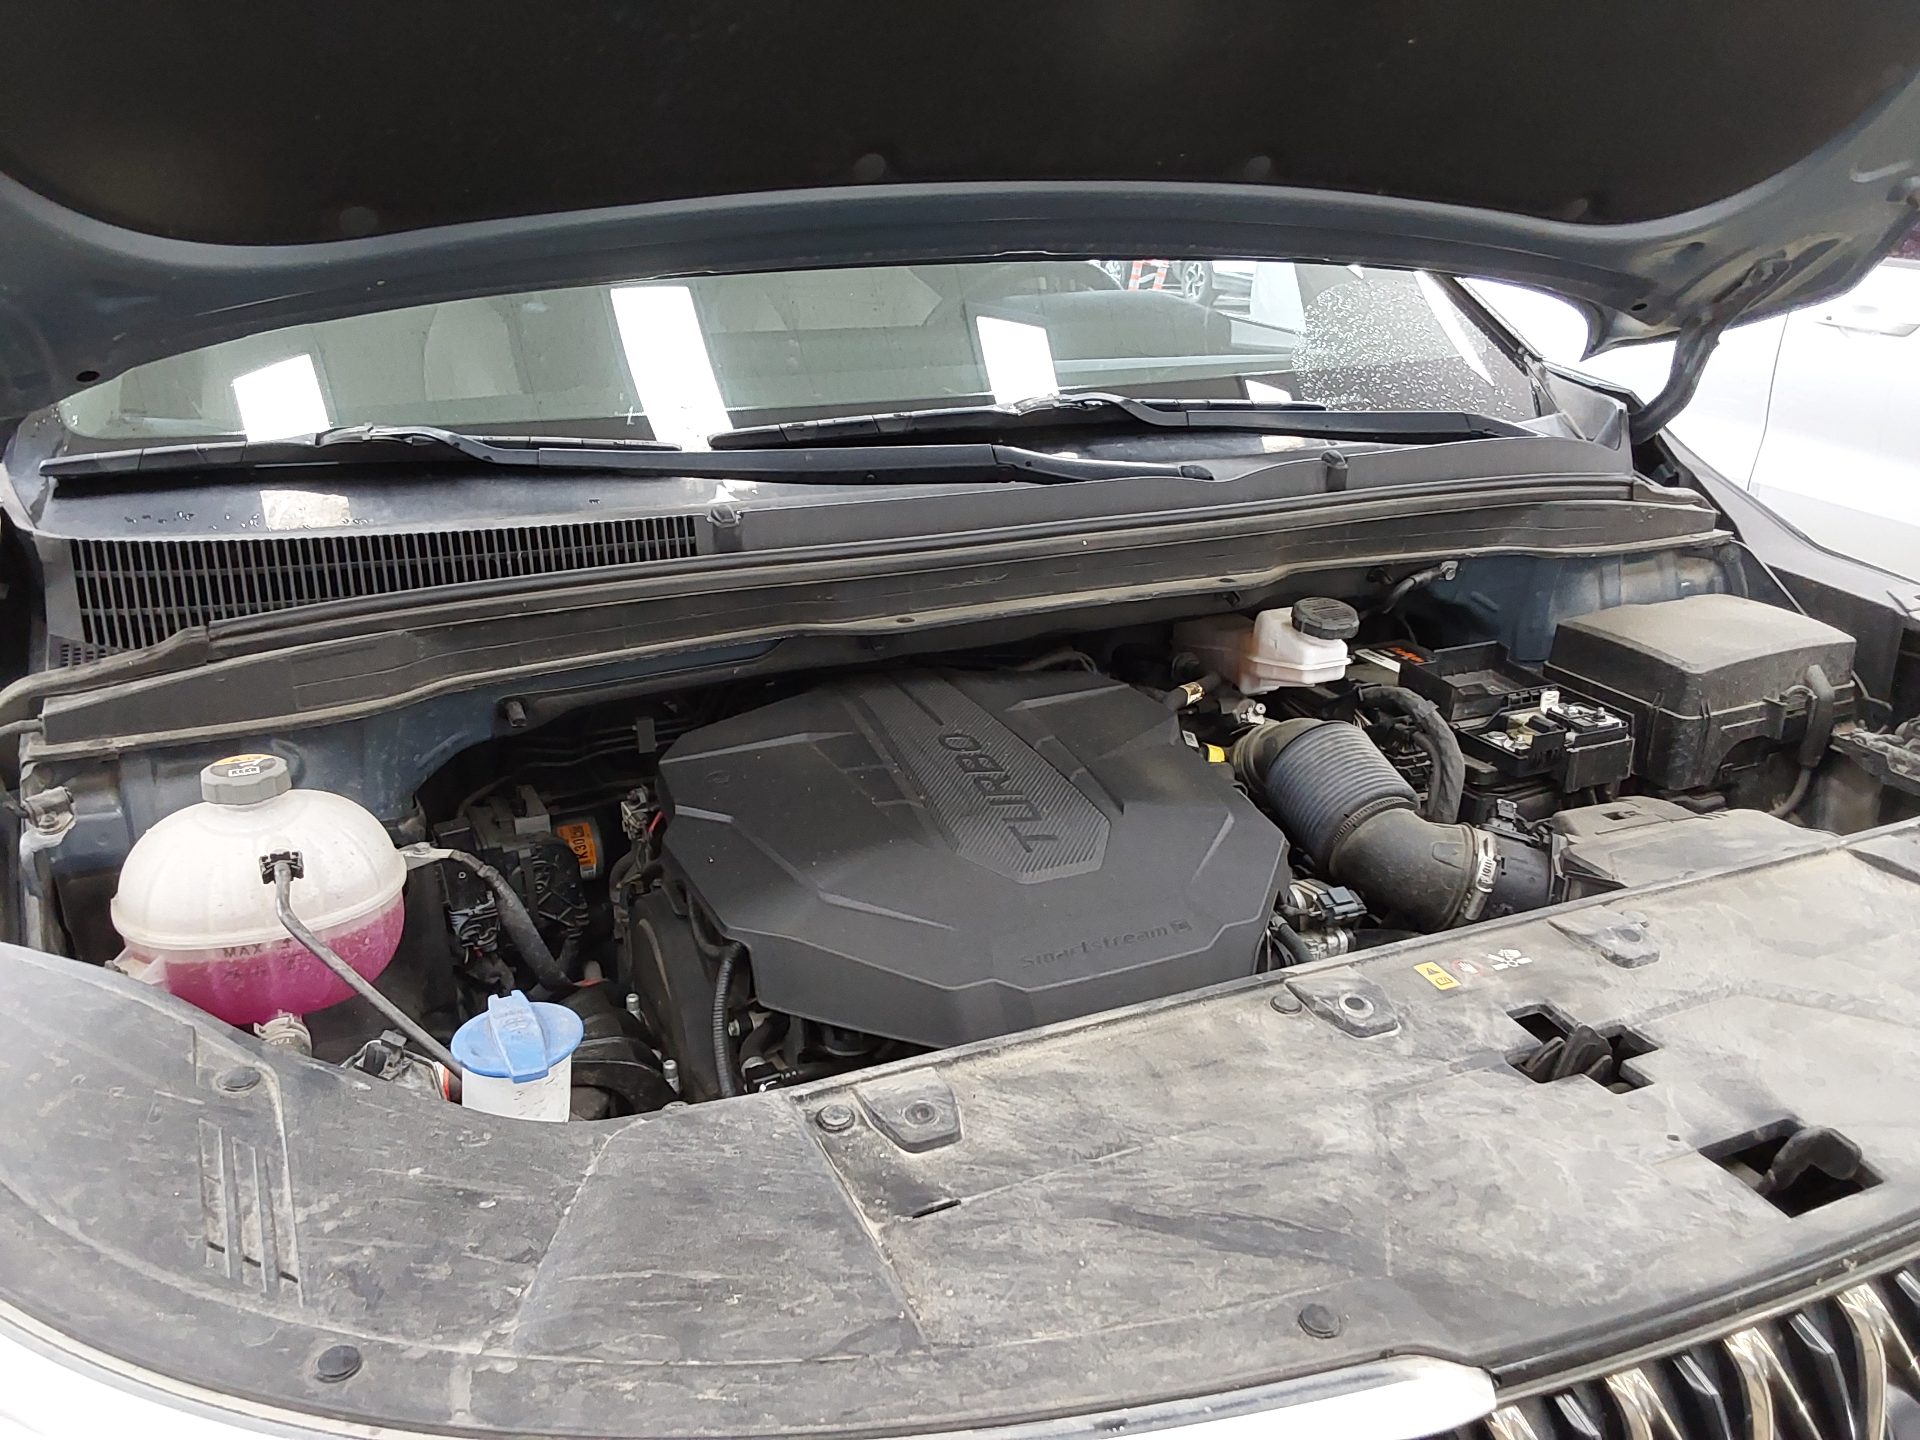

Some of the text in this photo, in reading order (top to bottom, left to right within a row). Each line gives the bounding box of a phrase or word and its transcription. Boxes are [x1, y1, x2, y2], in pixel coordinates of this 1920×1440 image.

[939, 732, 1058, 853] TURBO
[223, 943, 263, 958] MAX
[1020, 925, 1168, 968] Smartstream
